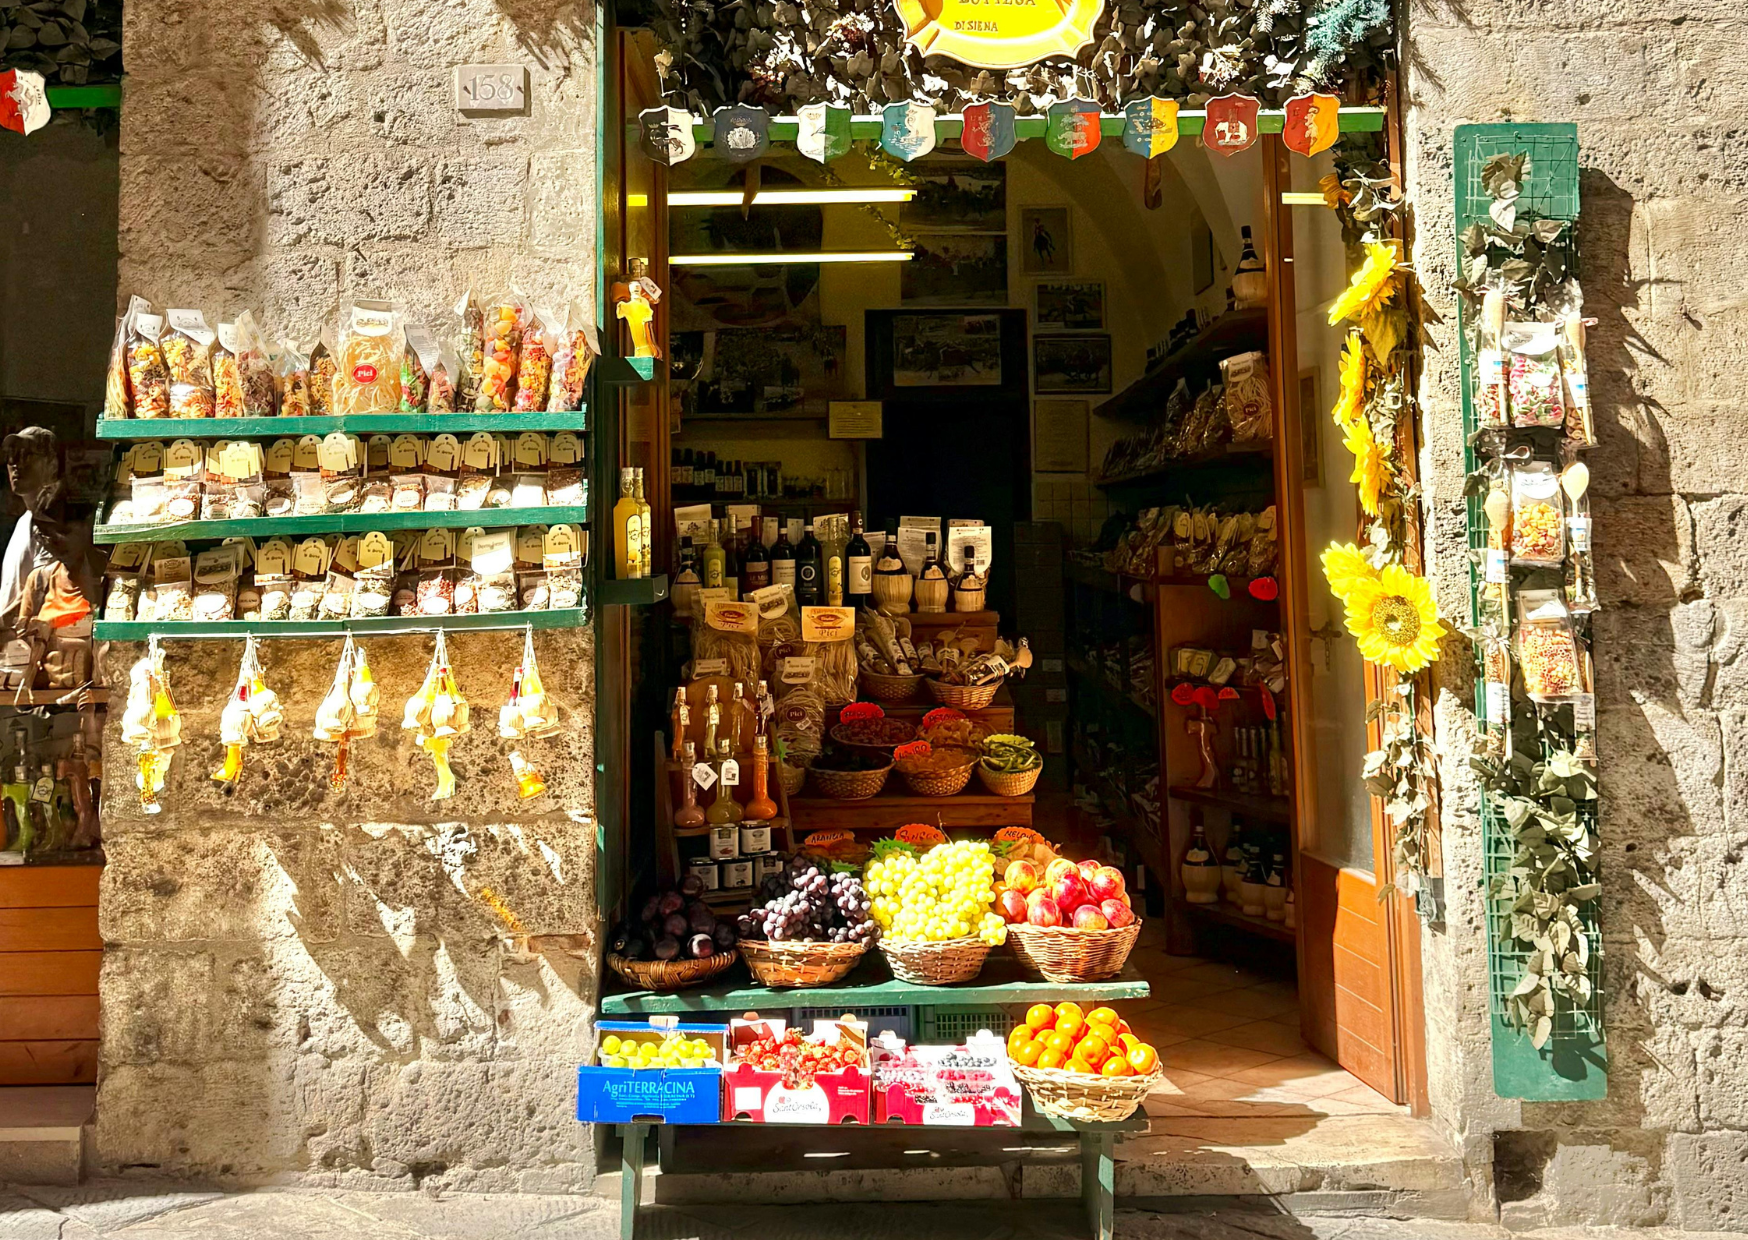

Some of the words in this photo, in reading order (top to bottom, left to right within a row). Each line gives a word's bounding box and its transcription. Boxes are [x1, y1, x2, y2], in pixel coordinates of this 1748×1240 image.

[954, 21, 965, 30] DI
[967, 20, 998, 31] SIENA
[468, 73, 514, 101] 158
[357, 369, 374, 378] Pici
[819, 629, 838, 637] Pici
[789, 710, 803, 718] Pici
[602, 1080, 695, 1098] AgriTERRACINA
